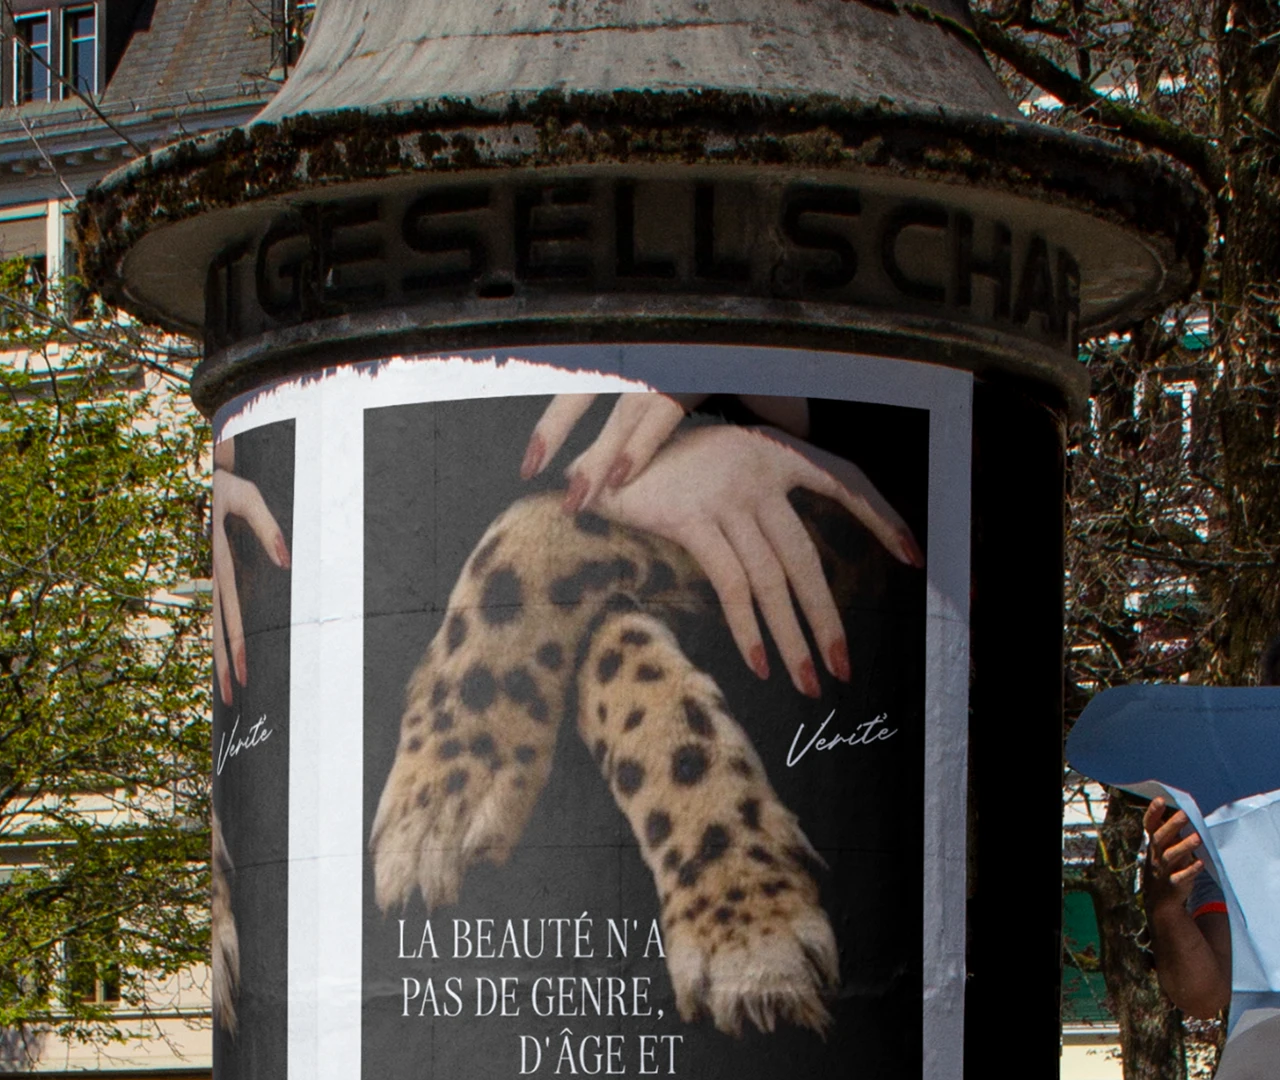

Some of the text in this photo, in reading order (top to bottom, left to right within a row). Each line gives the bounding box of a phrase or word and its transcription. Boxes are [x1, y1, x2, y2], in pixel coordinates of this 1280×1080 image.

[398, 911, 666, 958] LA BEAUTÉ N'A
[402, 977, 663, 1019] PAS DE GENRE,
[519, 1028, 683, 1074] D'ÂGE ET
